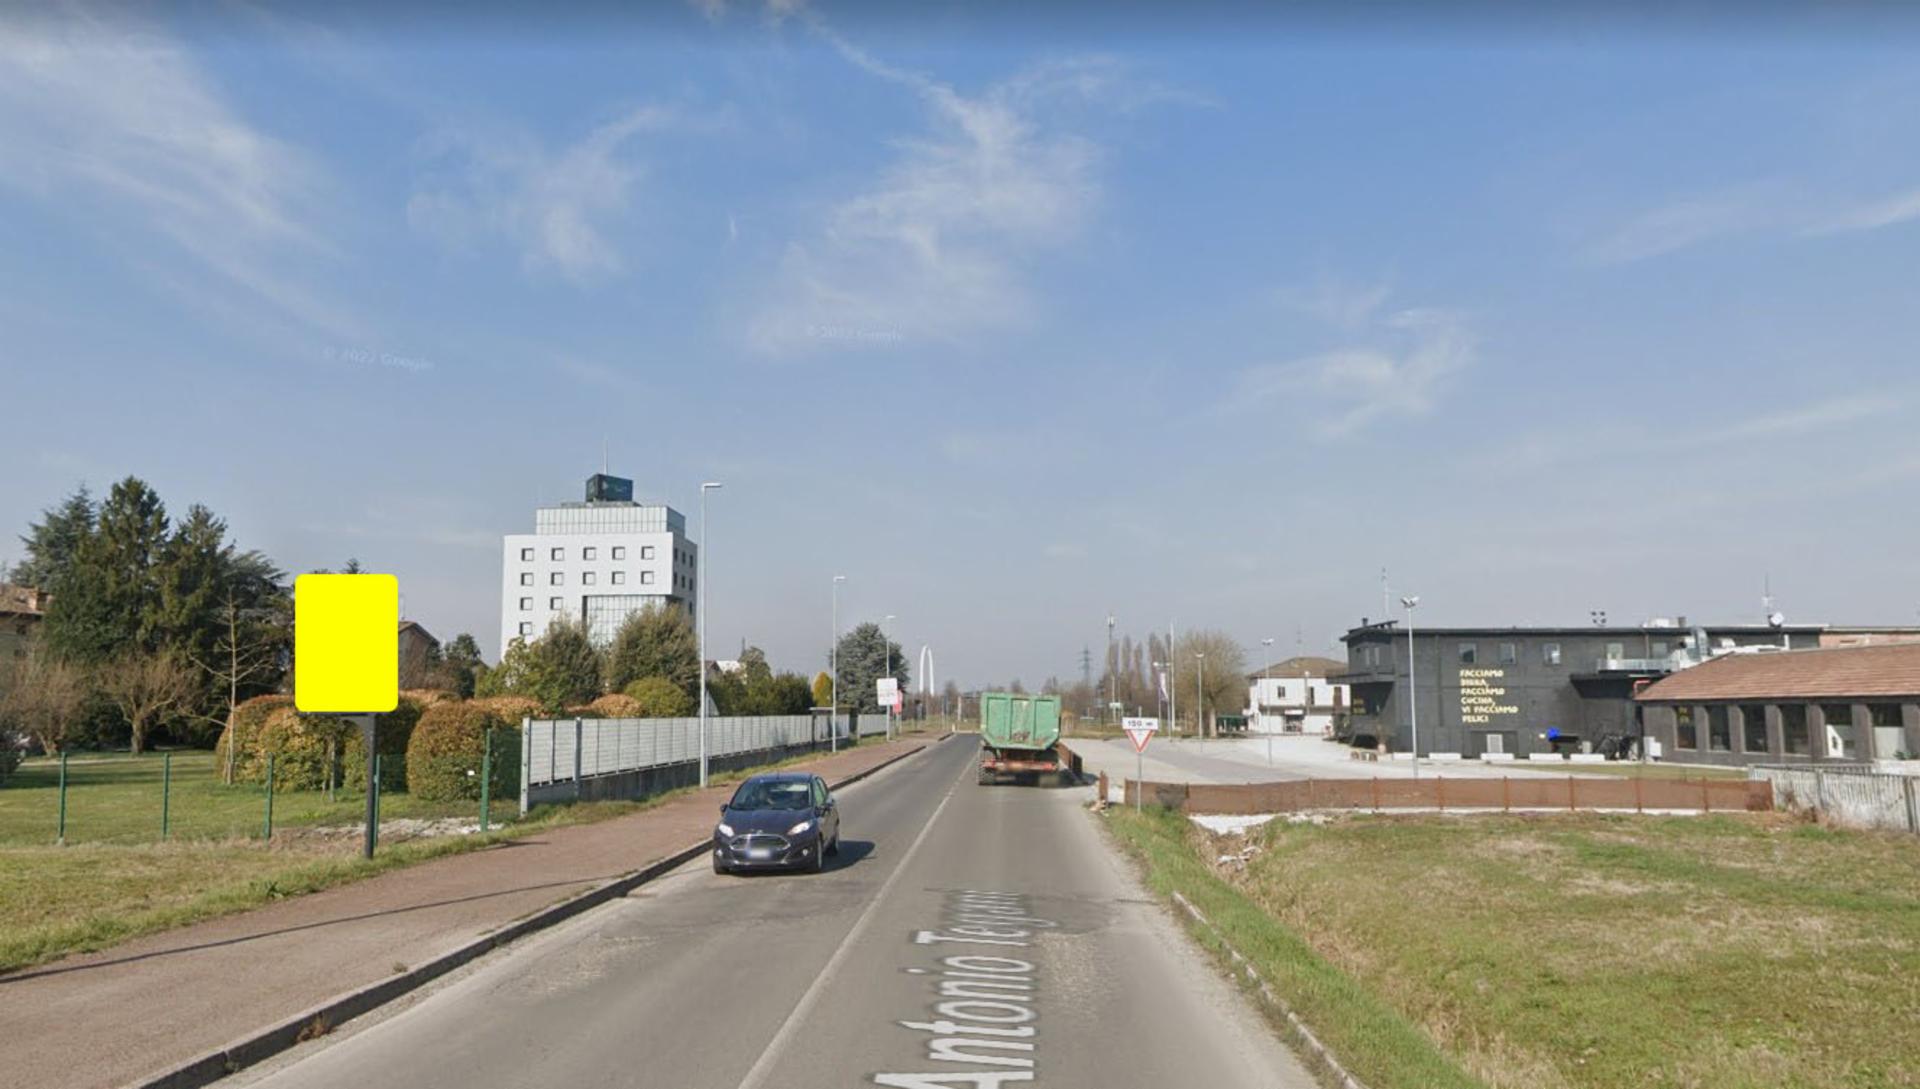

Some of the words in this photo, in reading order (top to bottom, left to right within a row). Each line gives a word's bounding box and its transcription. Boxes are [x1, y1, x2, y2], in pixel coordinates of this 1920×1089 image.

[1460, 669, 1504, 678] FACCIAMO
[1461, 687, 1505, 696] FACCIAMO
[1462, 705, 1471, 714] VI
[1474, 705, 1519, 714] FACCIAMO
